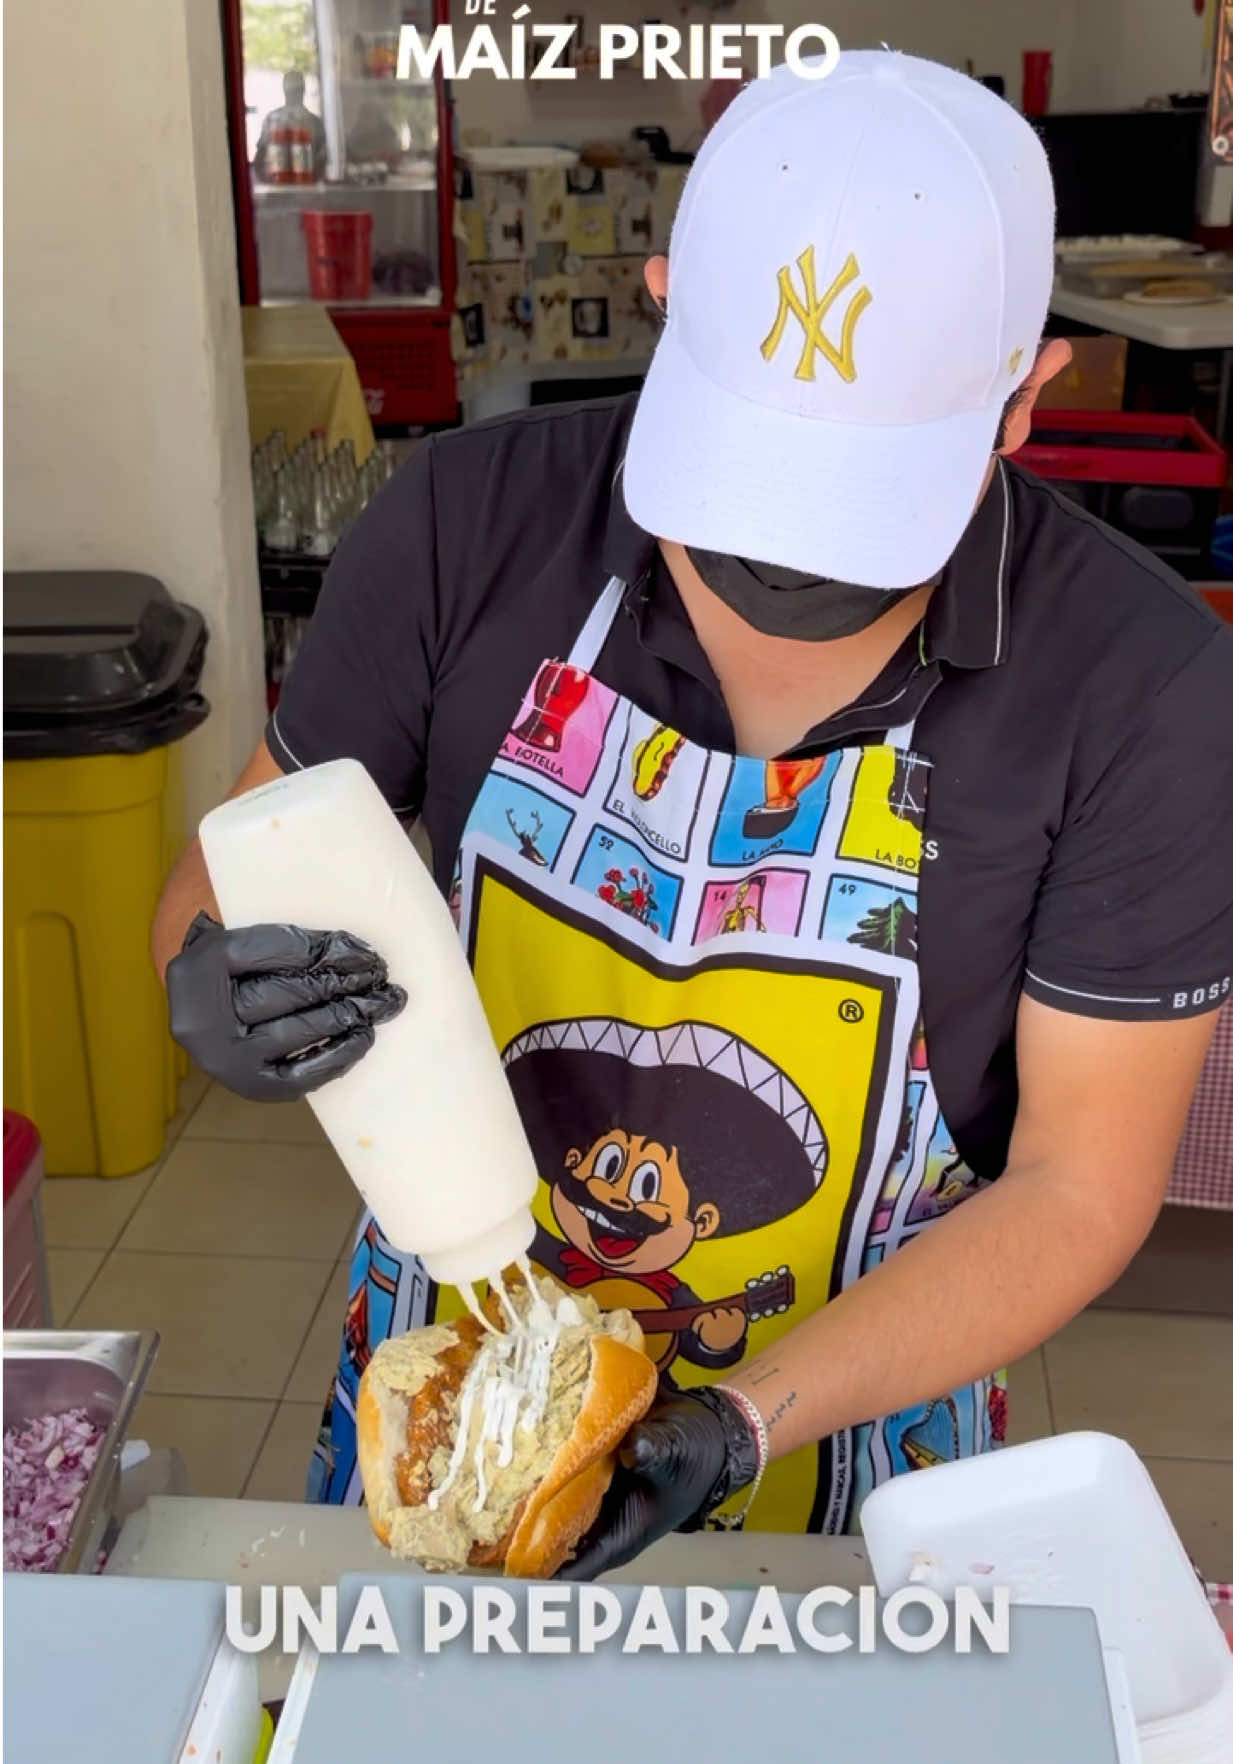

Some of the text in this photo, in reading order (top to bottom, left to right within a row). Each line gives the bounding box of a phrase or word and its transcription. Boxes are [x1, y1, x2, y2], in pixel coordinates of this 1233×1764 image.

[760, 244, 872, 384] NY
[875, 848, 920, 869] LA BO
[714, 891, 727, 902] 14
[838, 883, 856, 896] 49
[1172, 976, 1231, 1009] BOSS
